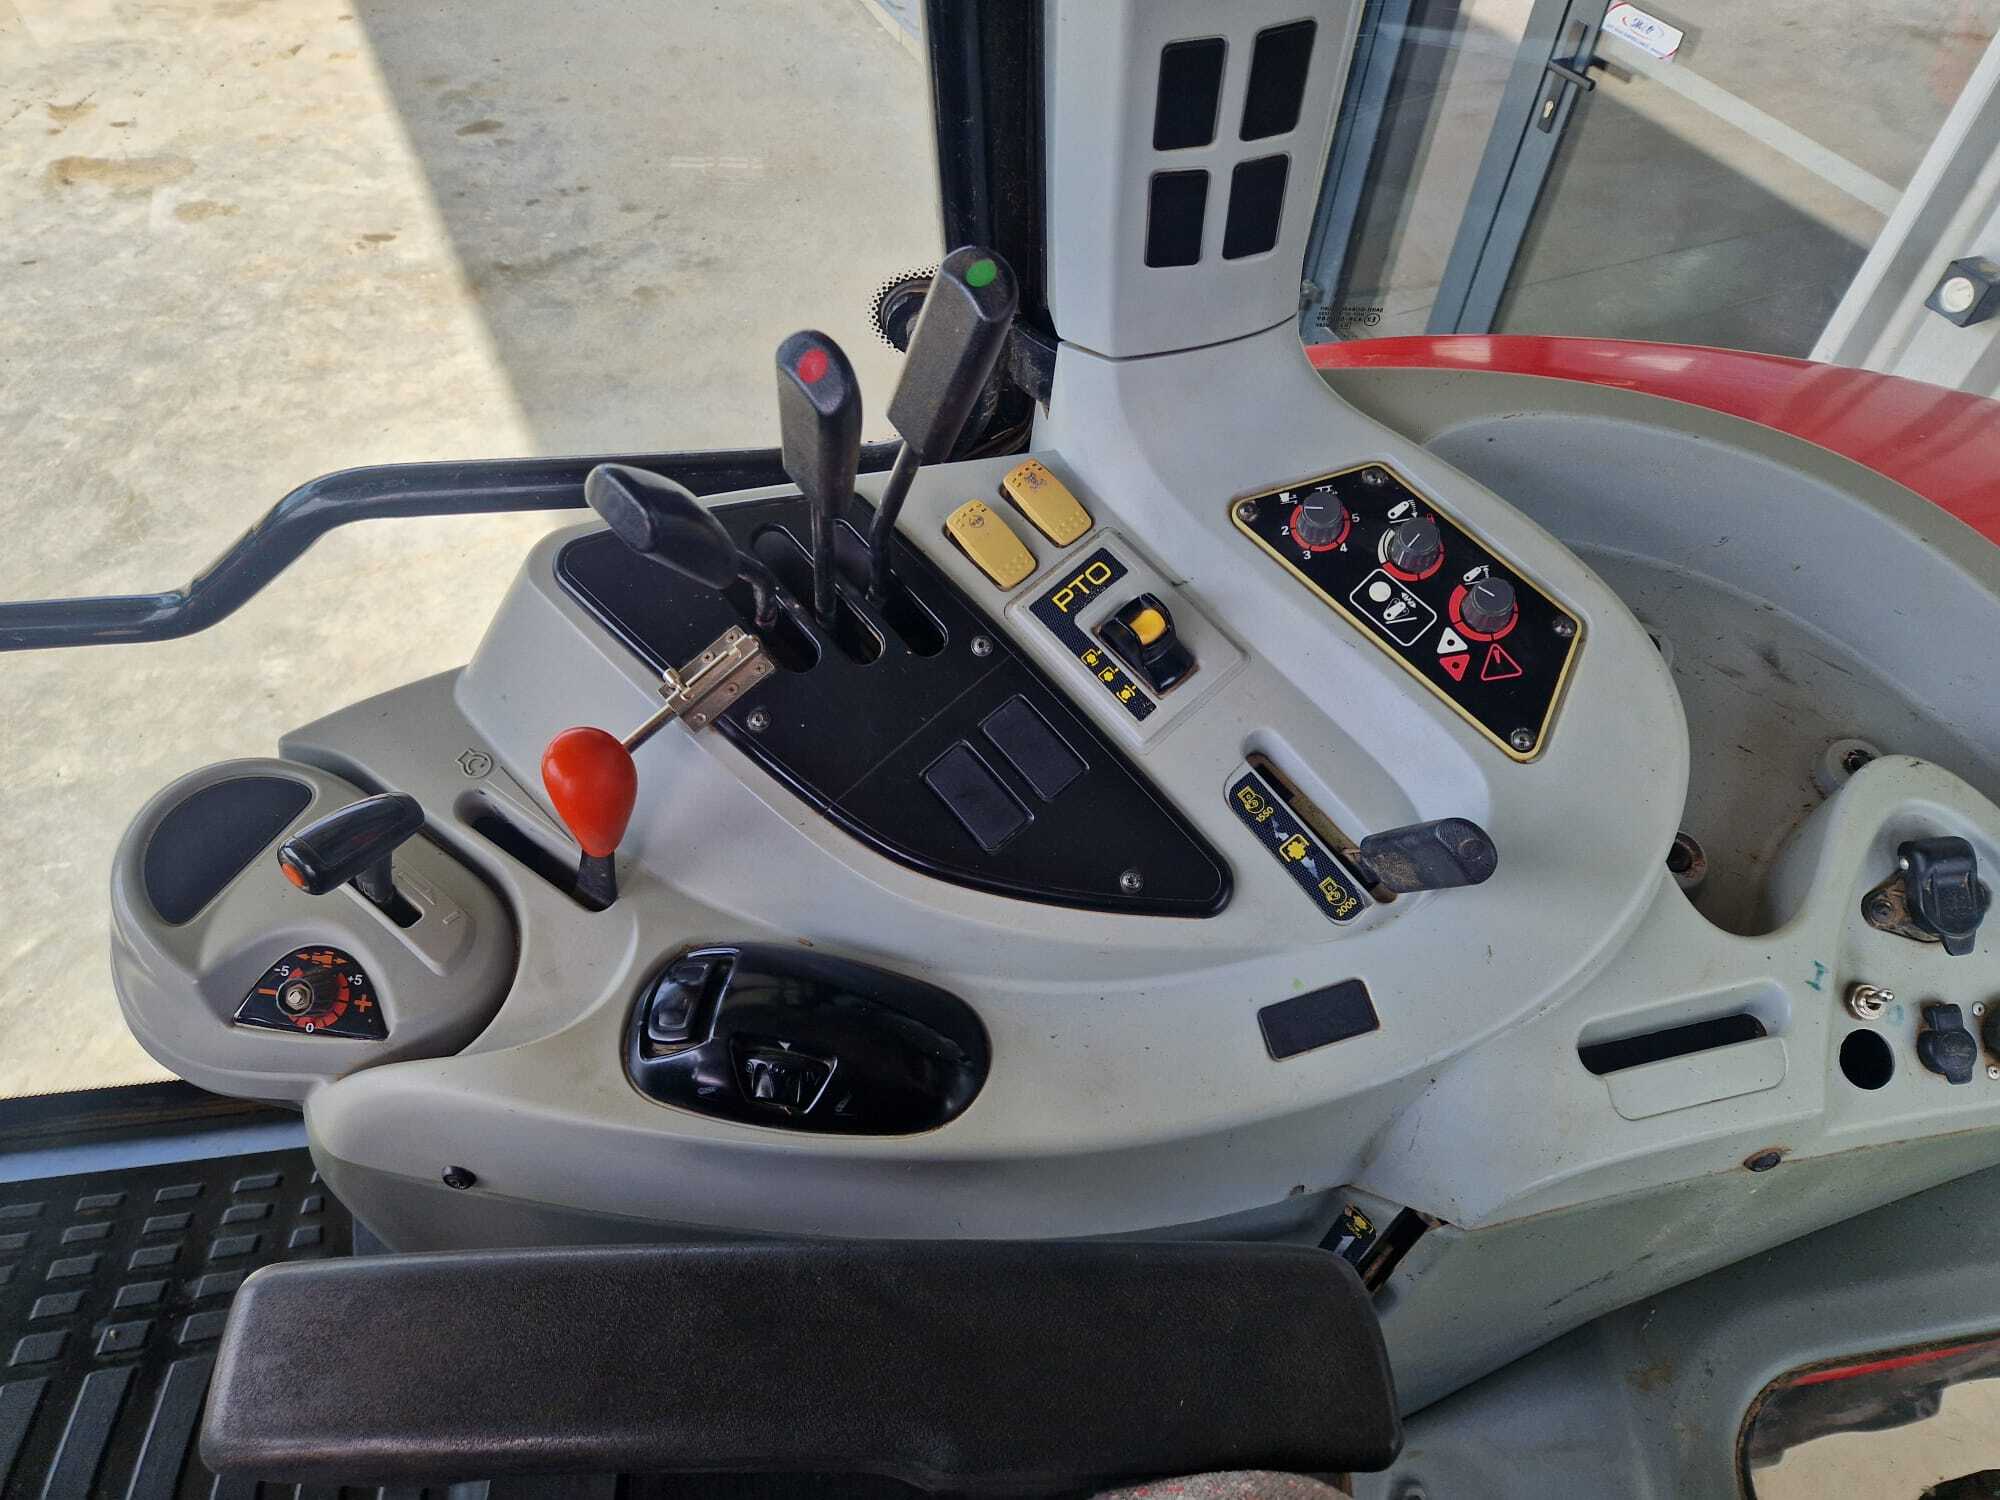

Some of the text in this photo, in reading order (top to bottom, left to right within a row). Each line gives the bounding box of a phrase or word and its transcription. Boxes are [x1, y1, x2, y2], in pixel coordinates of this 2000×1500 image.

[1351, 513, 1360, 523] 5
[1280, 525, 1290, 536] 2
[1339, 542, 1348, 553] 4
[1302, 550, 1312, 560] 3
[1051, 561, 1113, 613] PTO
[1336, 897, 1357, 917] 2000
[305, 1022, 315, 1033] 0
